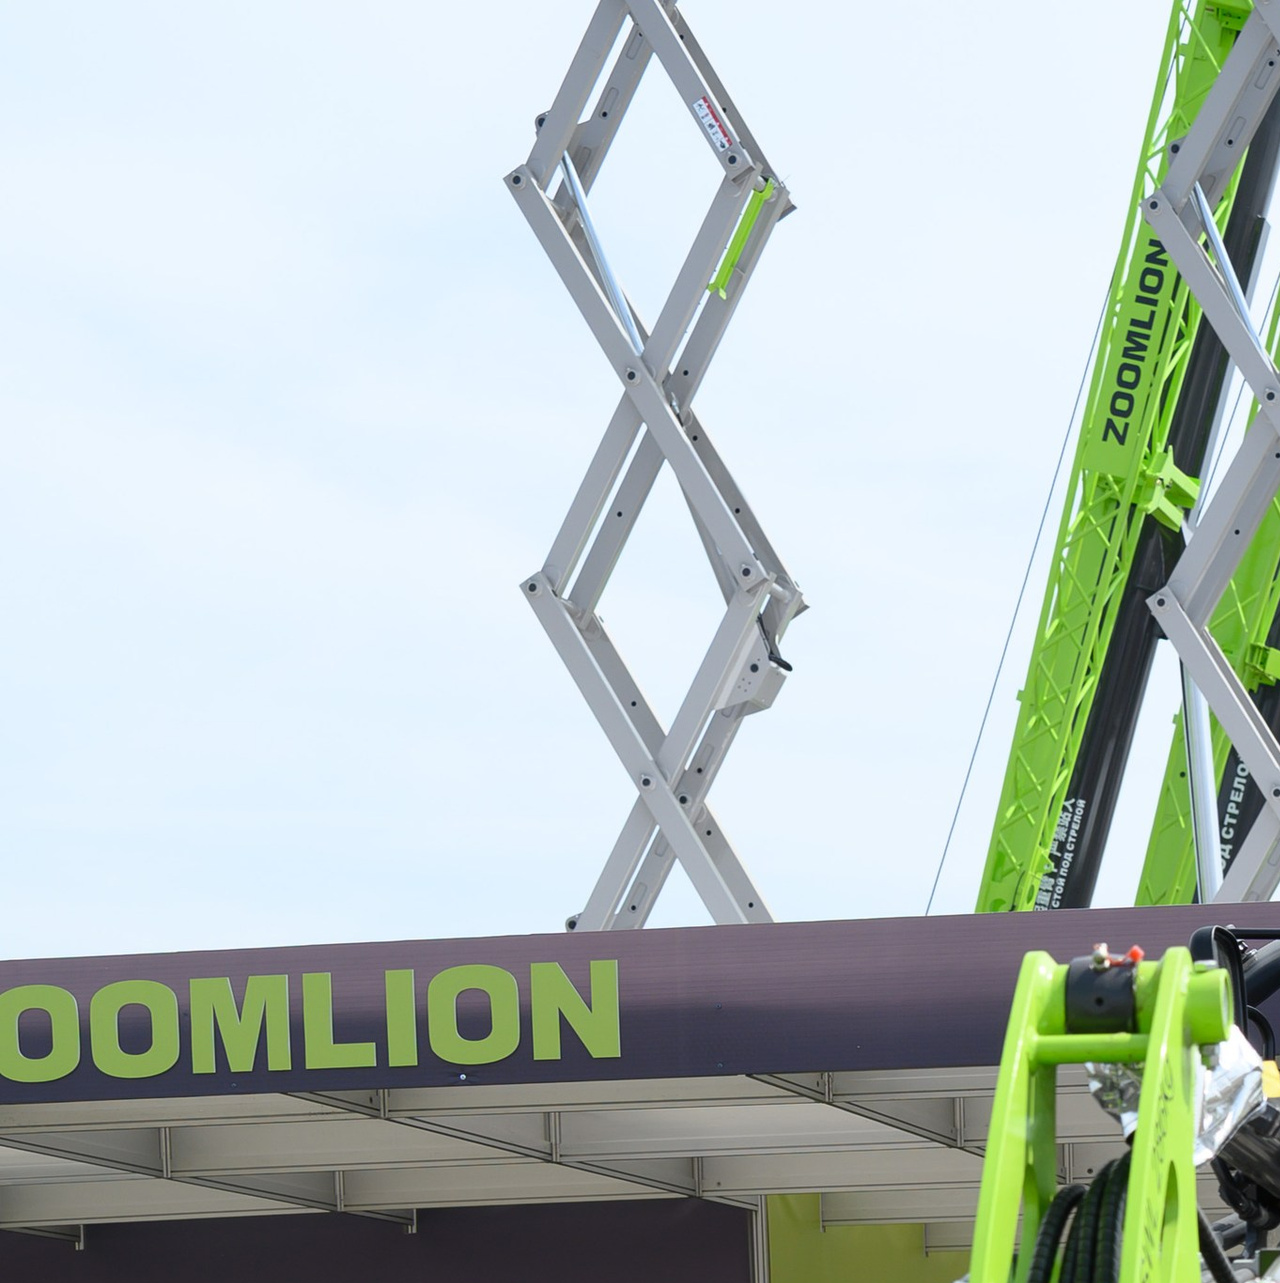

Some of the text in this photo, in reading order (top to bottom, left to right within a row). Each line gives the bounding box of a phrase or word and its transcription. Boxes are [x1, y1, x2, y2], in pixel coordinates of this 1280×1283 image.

[1102, 238, 1168, 446] ZOOMLION
[1221, 755, 1250, 840] СТРЕЛО
[1051, 798, 1087, 909] СТОЙ ПОД СТРЕЛОЙ
